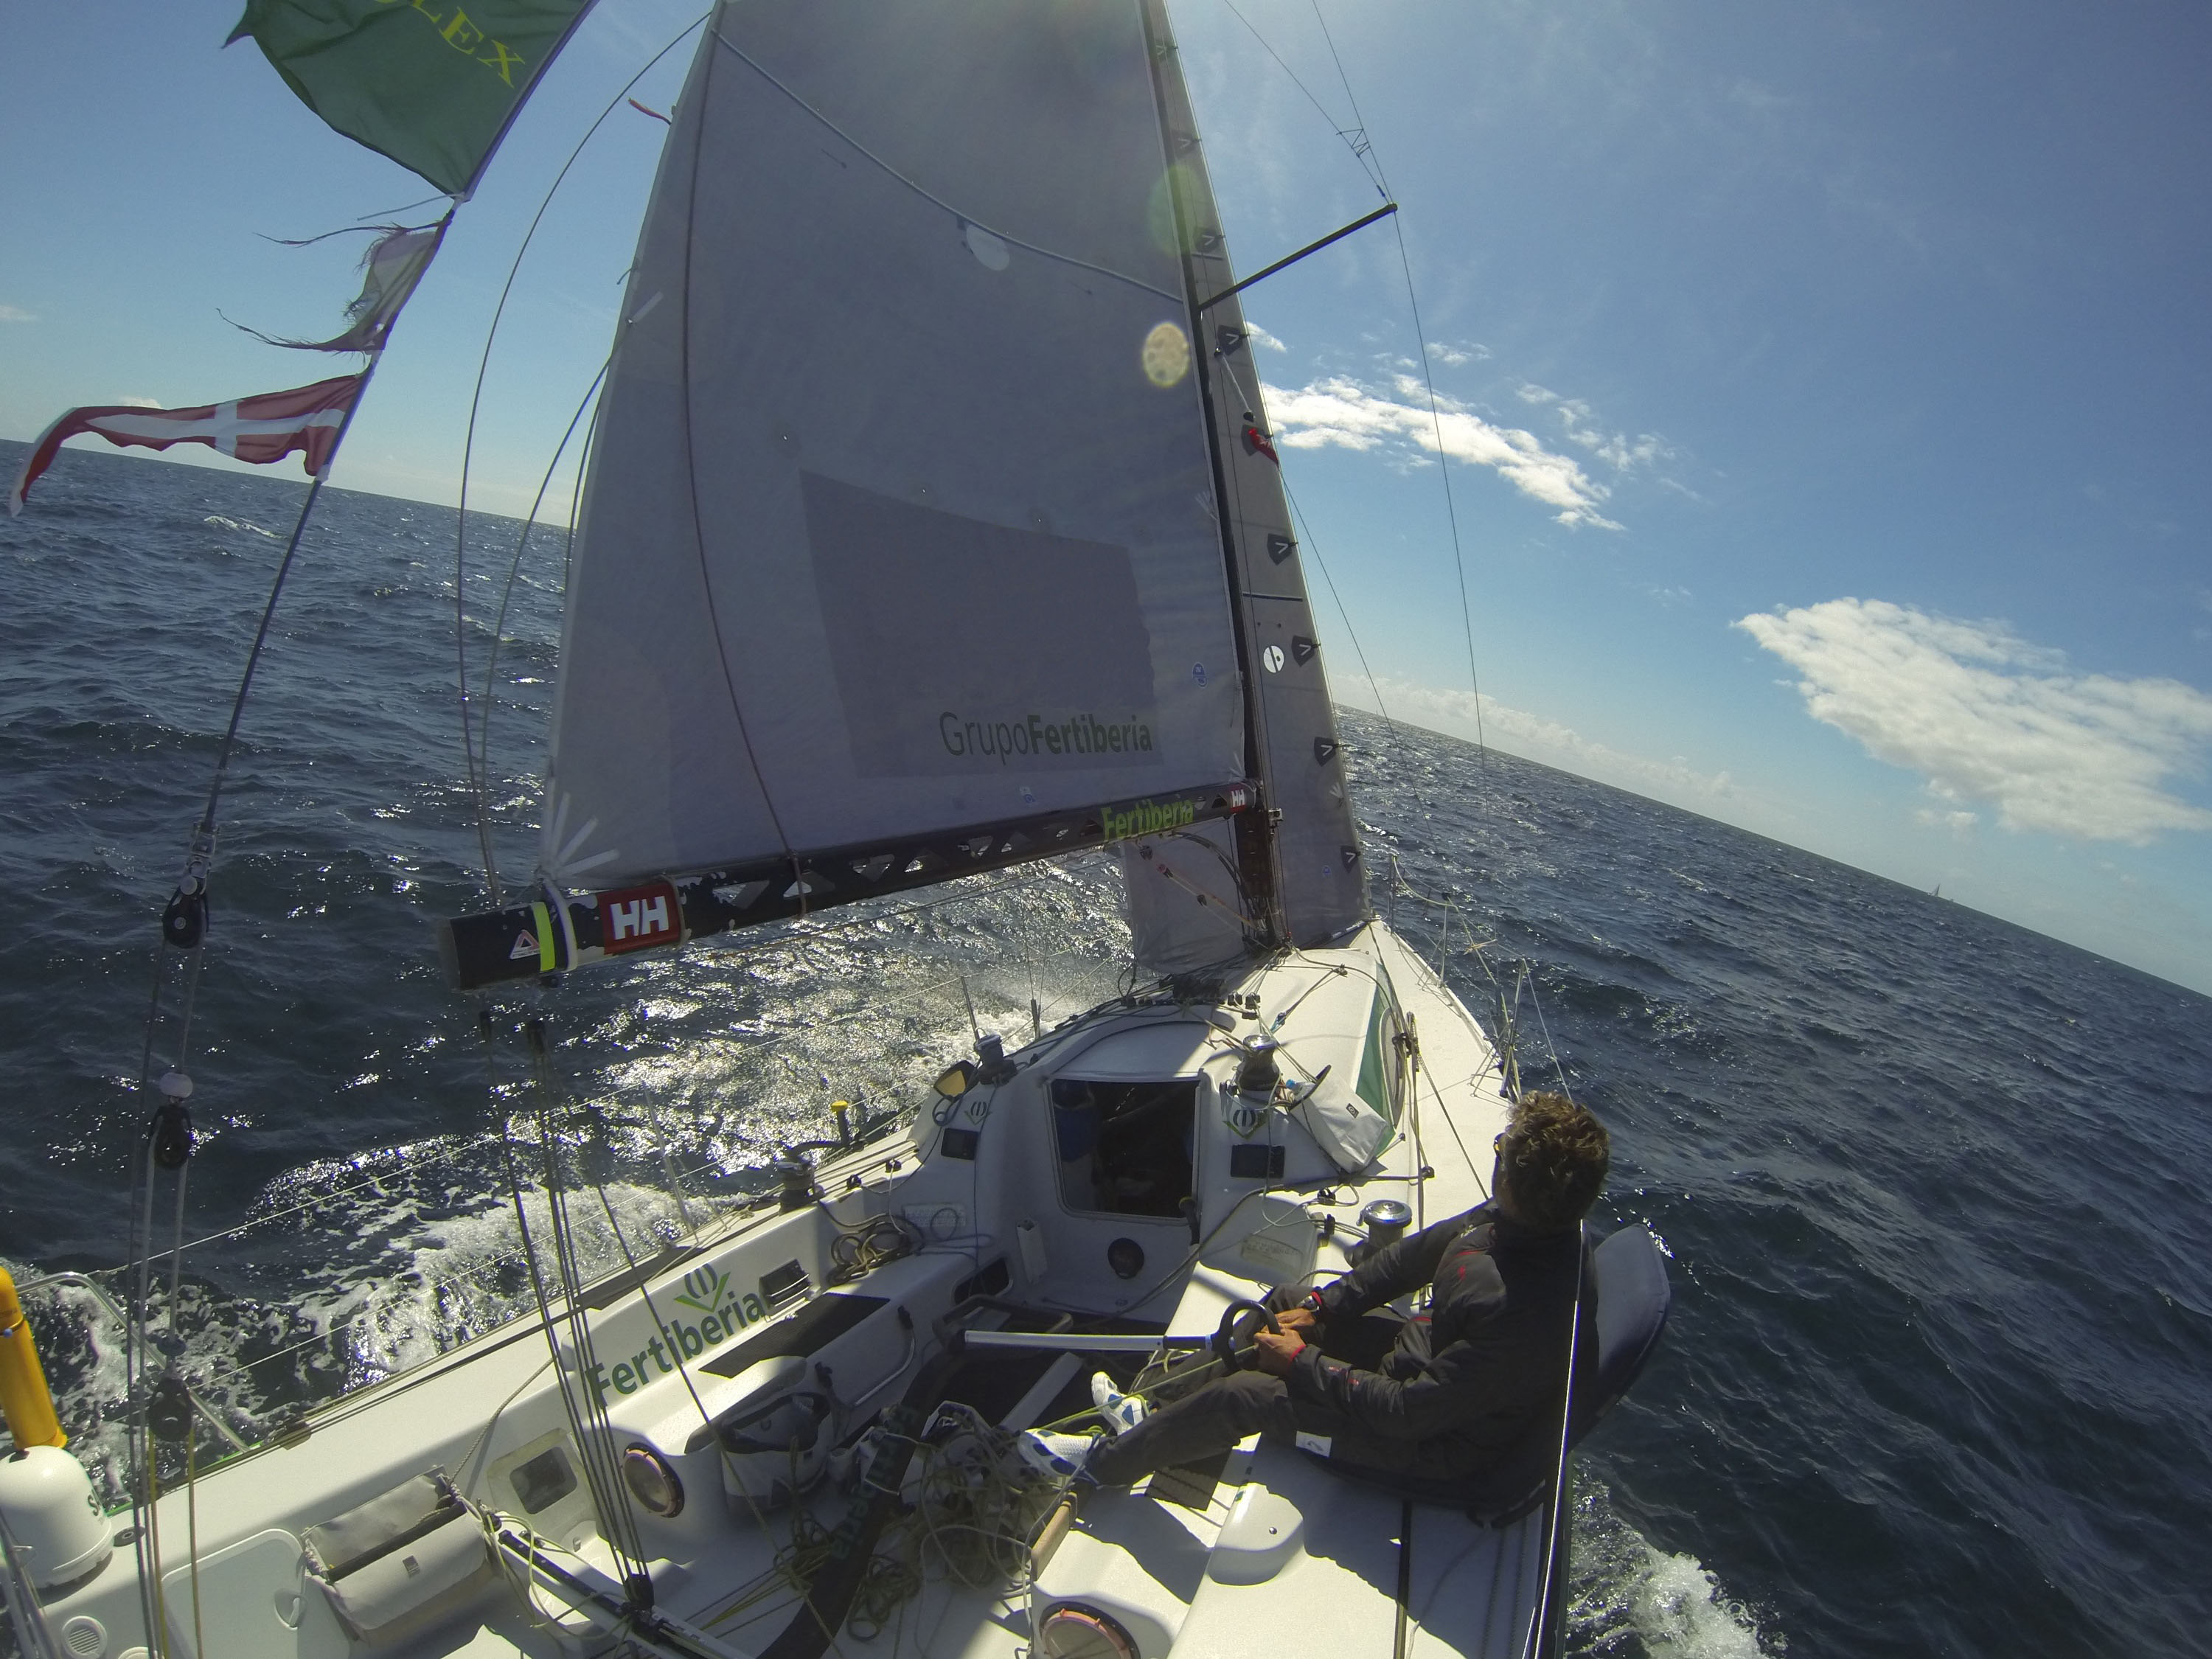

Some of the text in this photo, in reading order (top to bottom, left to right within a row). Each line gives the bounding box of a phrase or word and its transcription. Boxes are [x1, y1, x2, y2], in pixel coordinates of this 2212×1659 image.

[372, 0, 525, 88] EX
[939, 711, 1153, 765] GrupoFertiberia
[1102, 799, 1194, 841] Fertiberia
[610, 896, 669, 940] HH
[585, 1291, 766, 1409] Fertiberia
